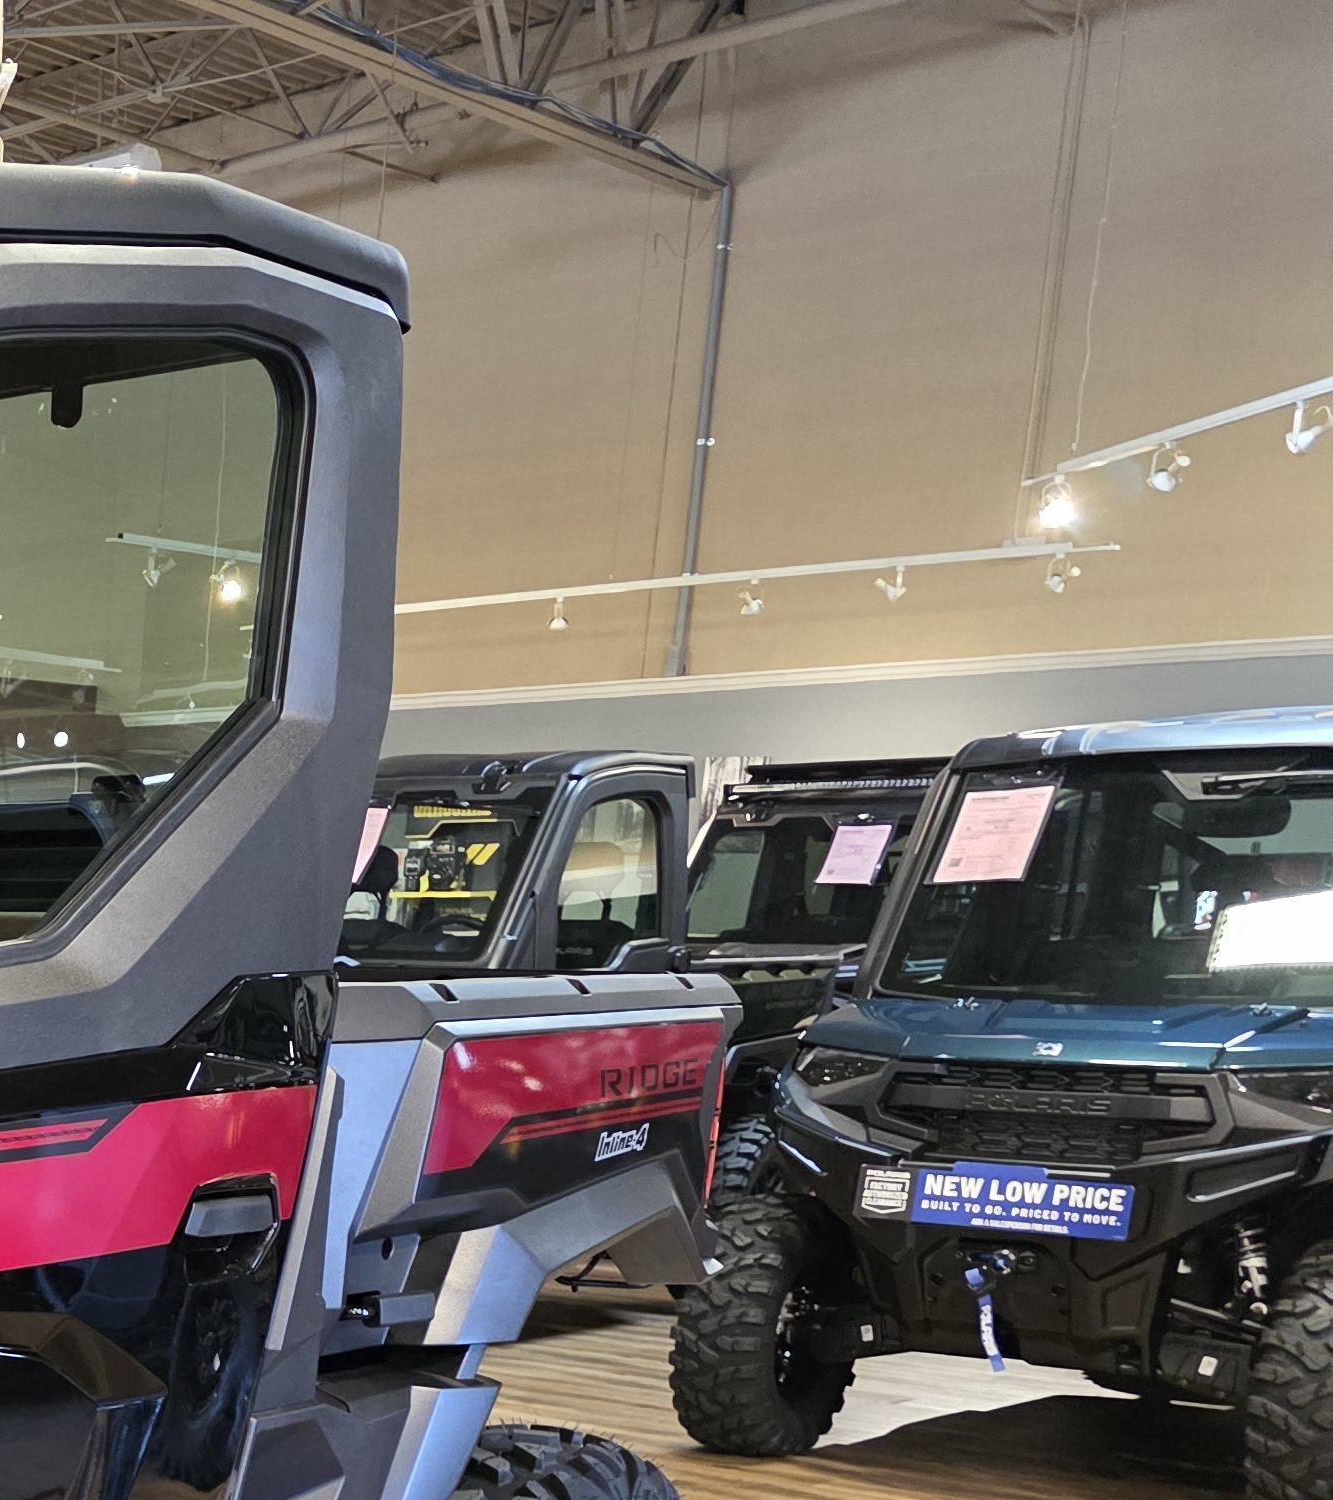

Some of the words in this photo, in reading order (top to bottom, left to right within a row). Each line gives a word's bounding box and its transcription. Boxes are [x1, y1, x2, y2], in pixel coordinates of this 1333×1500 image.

[599, 1057, 699, 1099] RIDGE
[921, 1199, 960, 1212] BUILT
[964, 1202, 981, 1214] TO
[1010, 1207, 1060, 1221] PRICED
[1063, 1211, 1080, 1223] TO
[1082, 1213, 1122, 1227] MOVE.
[923, 1173, 985, 1200] NEW
[988, 1179, 1049, 1205] LOW
[1051, 1184, 1127, 1213] PRICE
